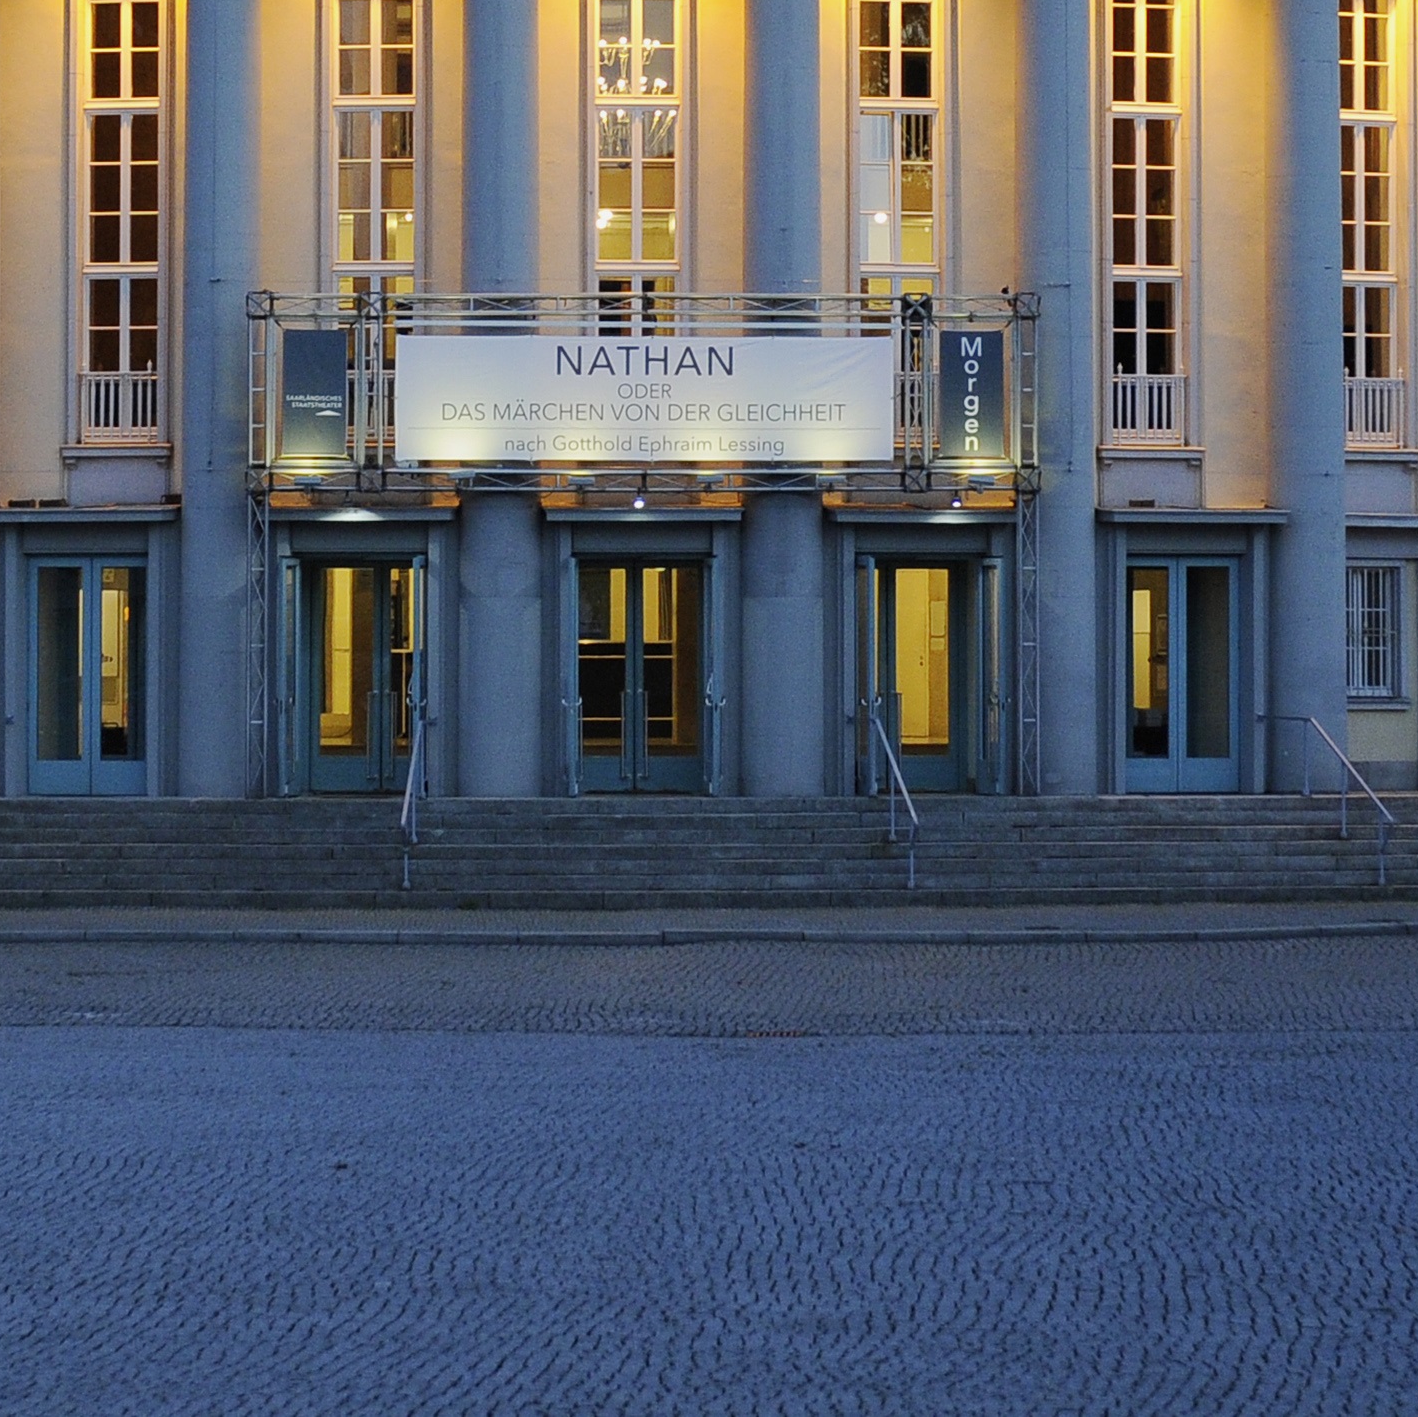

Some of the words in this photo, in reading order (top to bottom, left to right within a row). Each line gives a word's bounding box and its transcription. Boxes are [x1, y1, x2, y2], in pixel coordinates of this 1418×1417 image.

[555, 345, 734, 376] NATHAN
[617, 383, 672, 400] ODER
[960, 336, 983, 452] Morgen
[291, 401, 343, 409] STAATSTHEATER
[441, 403, 486, 421] DAS
[492, 398, 604, 422] MÄRCHEN
[610, 403, 660, 422] VON
[667, 403, 711, 422] DER
[716, 403, 846, 422] GLEICHHEIT
[504, 435, 547, 452] nach
[552, 435, 633, 453] Gotthold
[638, 436, 713, 456] Ephraim
[718, 436, 785, 456] Lessing
